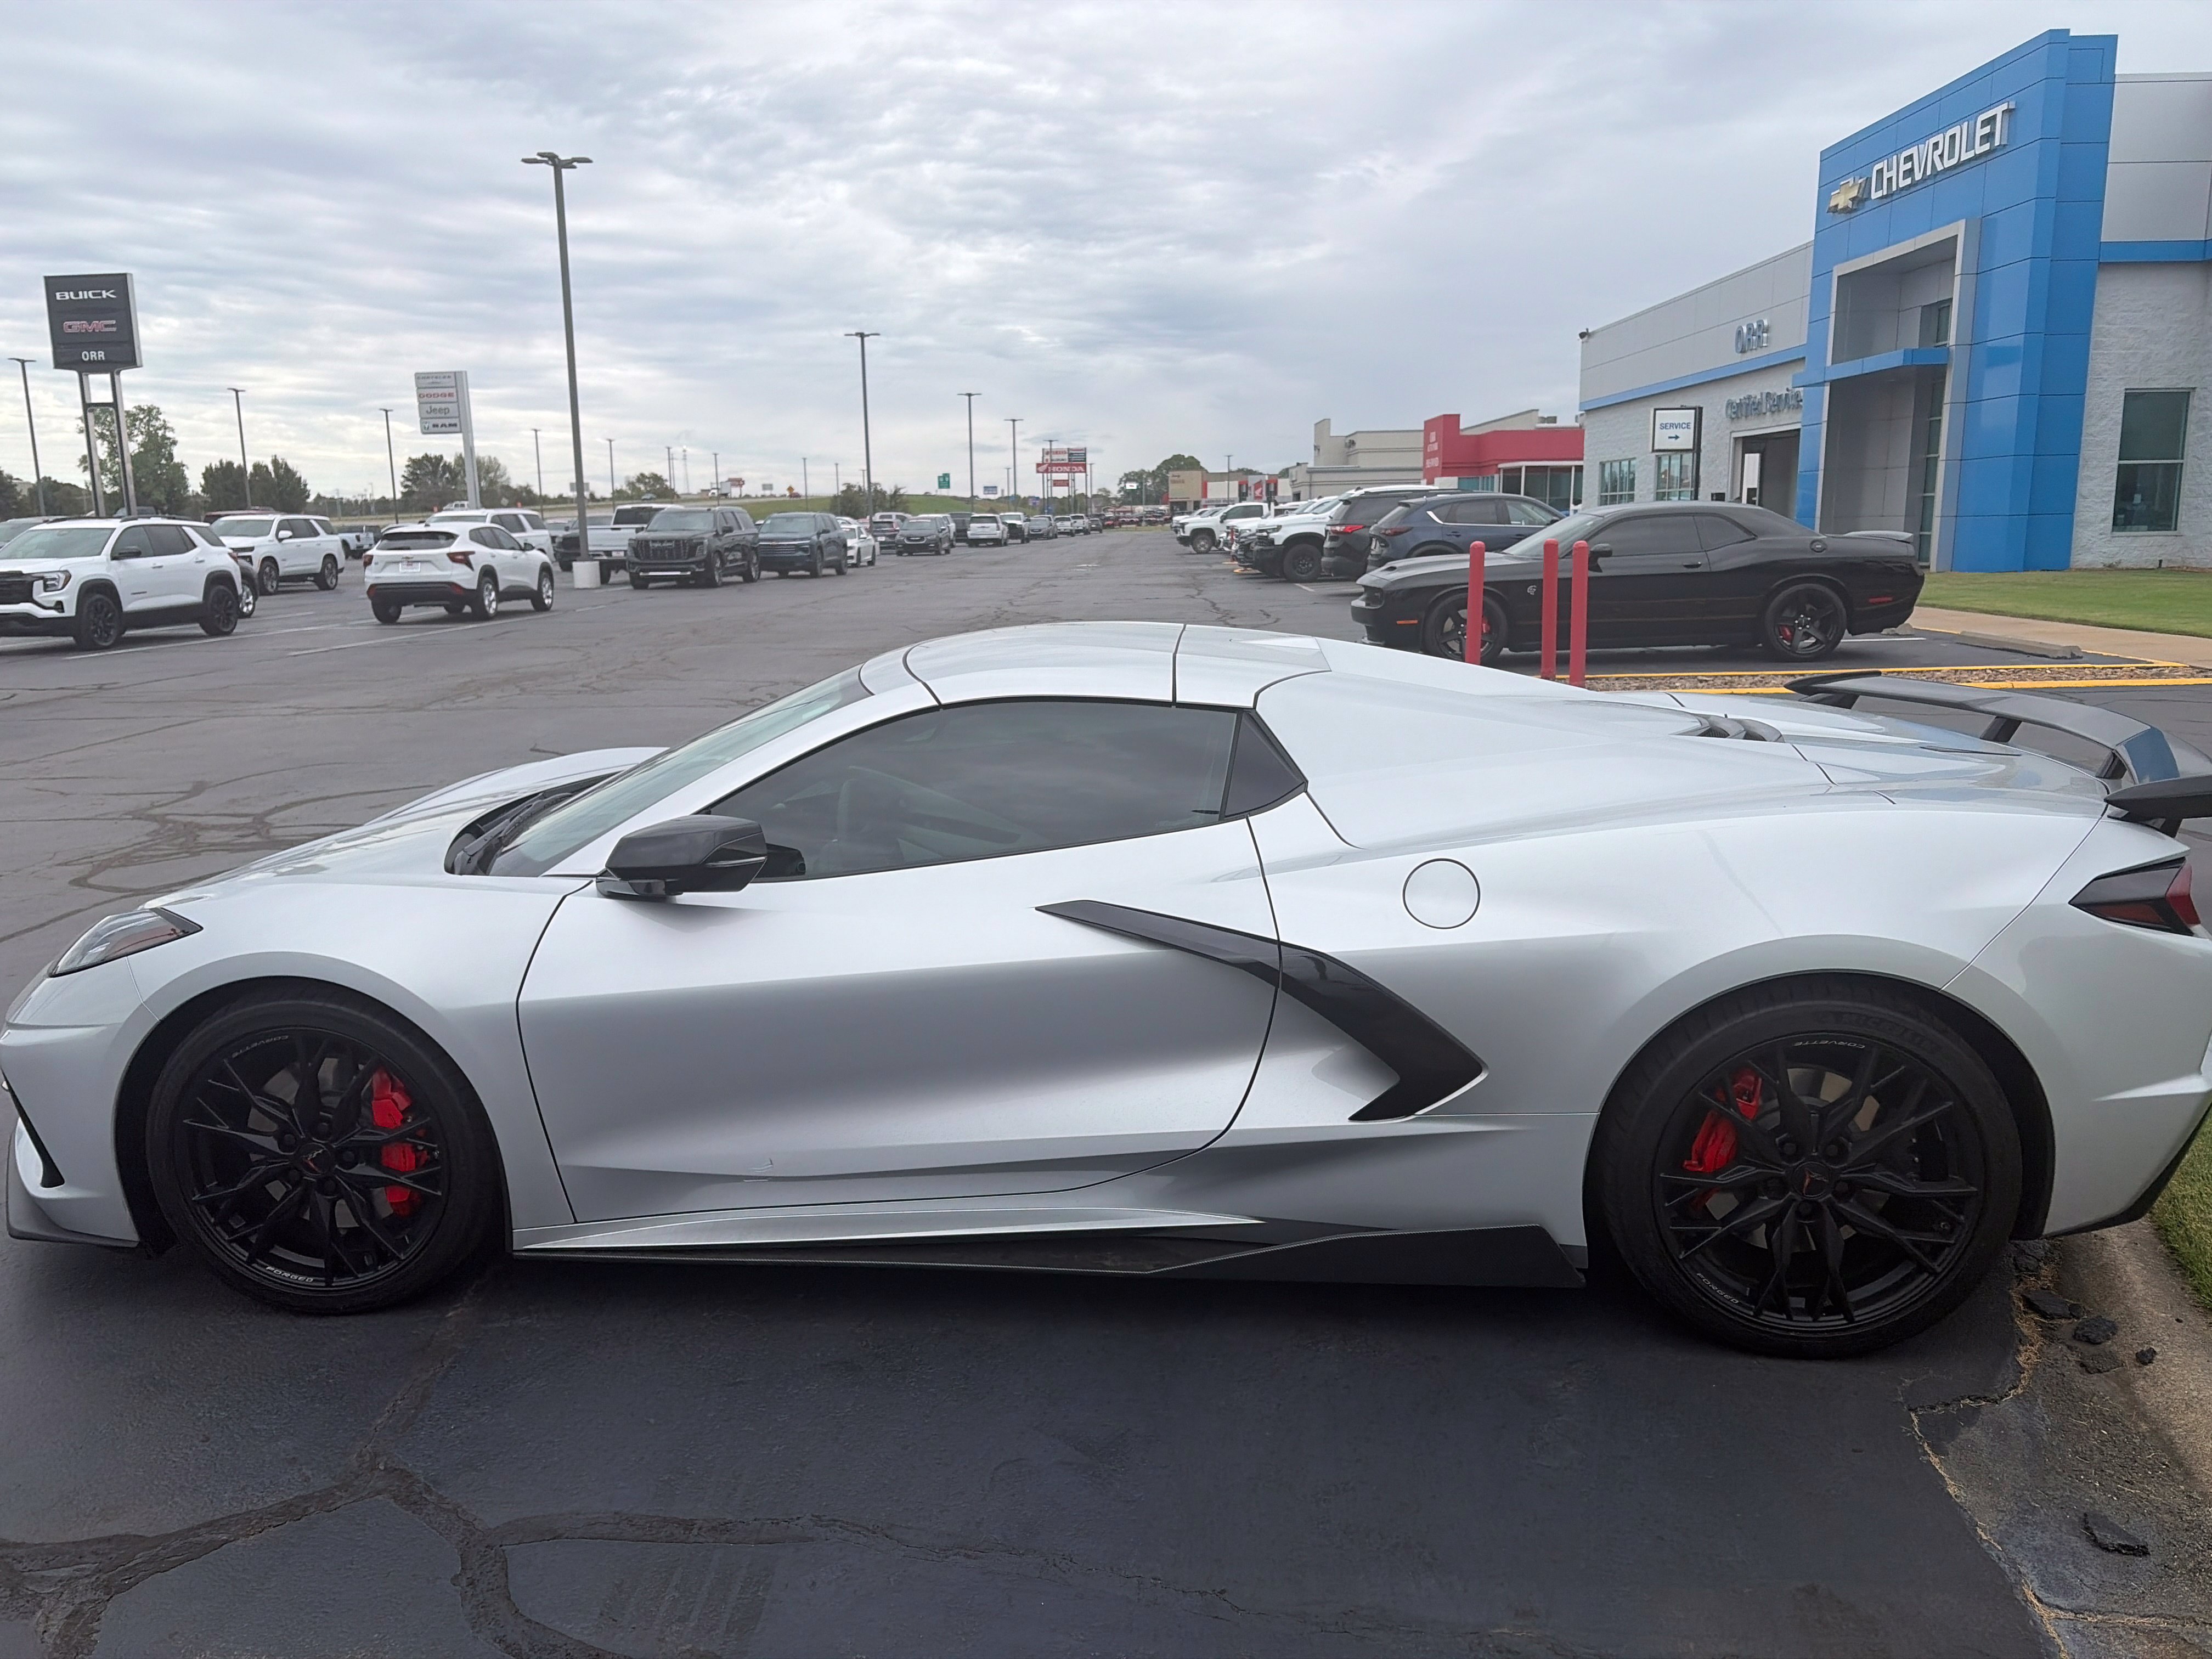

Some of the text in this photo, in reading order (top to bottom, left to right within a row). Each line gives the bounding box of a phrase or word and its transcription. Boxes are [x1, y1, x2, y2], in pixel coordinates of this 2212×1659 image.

[1871, 101, 2012, 200] CHEVROLET
[55, 290, 116, 300] BUICK
[63, 320, 117, 333] GMC
[1735, 319, 1767, 354] ORR
[82, 351, 105, 362] ORR
[426, 405, 450, 415] Jeep
[1725, 392, 1767, 419] Certified
[1660, 422, 1691, 430] SERVICE
[232, 1035, 289, 1059] CORVETTE
[1793, 1040, 1866, 1049] CORVETTE
[266, 1266, 314, 1283] FORGED
[1696, 1272, 1740, 1304] FORGED
